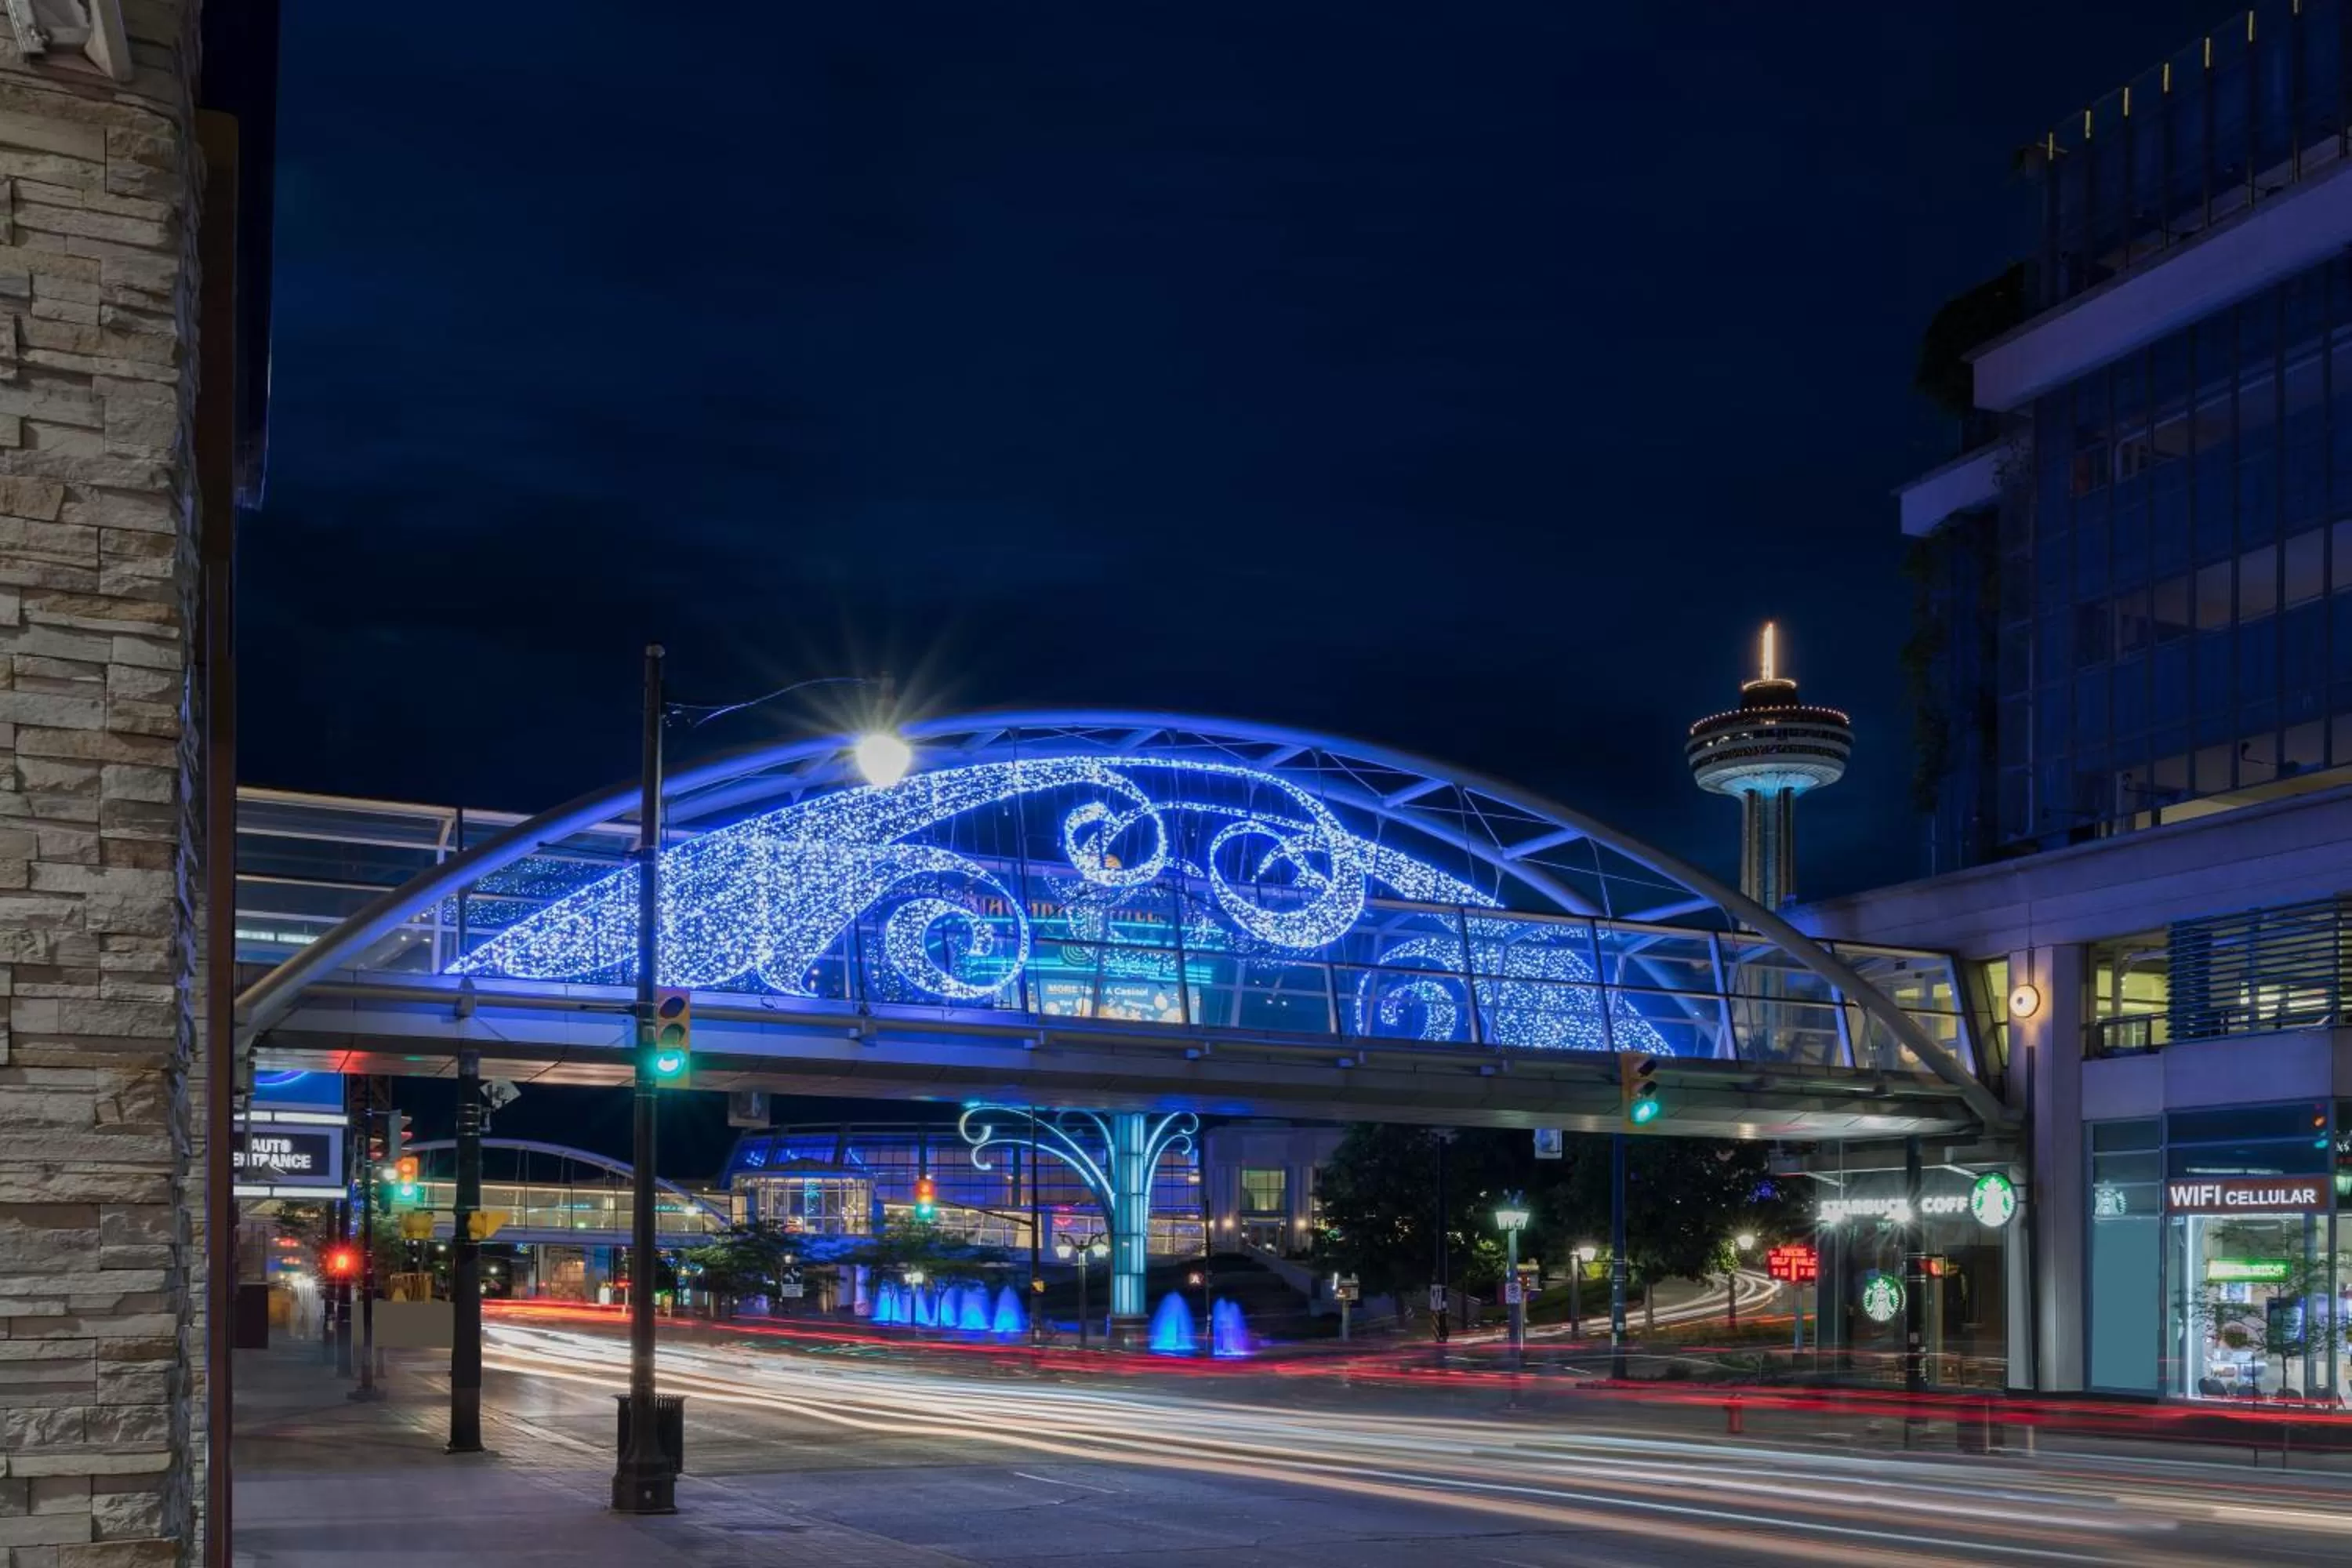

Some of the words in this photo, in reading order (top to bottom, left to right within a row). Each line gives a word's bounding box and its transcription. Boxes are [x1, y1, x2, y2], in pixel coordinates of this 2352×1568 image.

[1047, 984, 1078, 995] MORE
[251, 1138, 292, 1153] AUTO
[2169, 1185, 2221, 1207] WIFI
[2224, 1189, 2317, 1206] CELLULAR
[1820, 1198, 1909, 1216] STARBUCK
[1921, 1196, 1969, 1214] COFF
